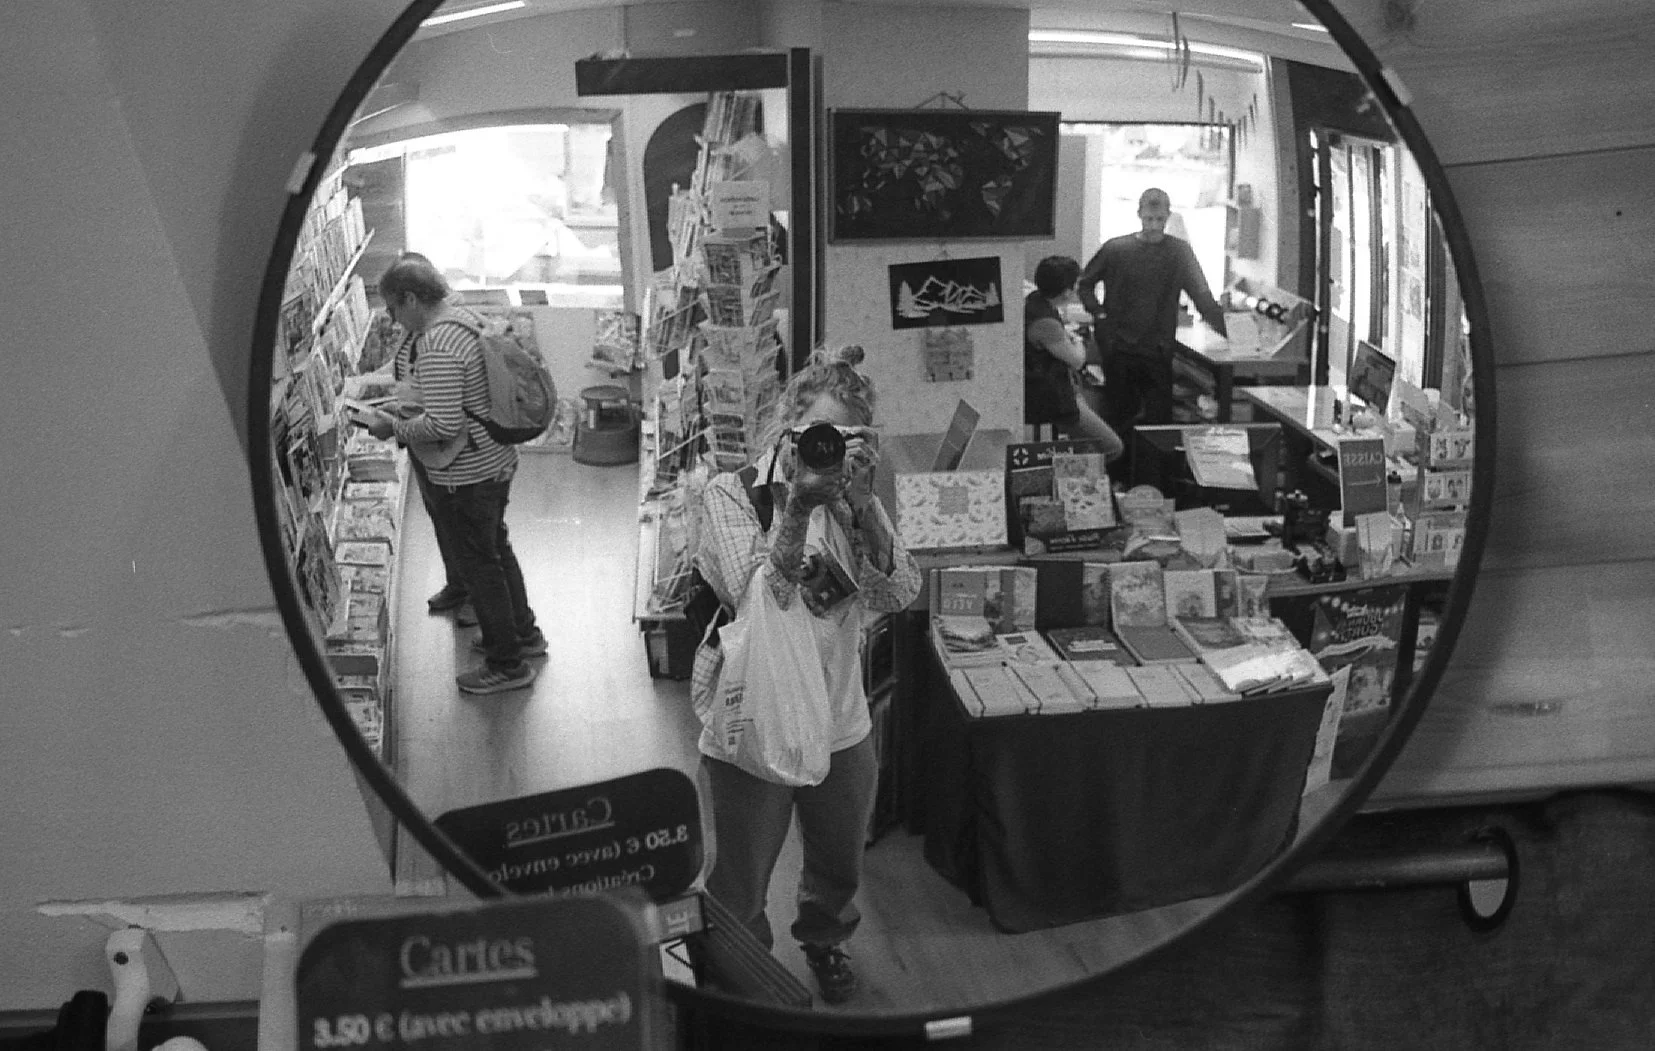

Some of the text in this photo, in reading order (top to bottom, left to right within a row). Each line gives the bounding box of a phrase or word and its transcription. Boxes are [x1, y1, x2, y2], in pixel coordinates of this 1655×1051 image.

[402, 934, 536, 977] Cartes
[375, 1012, 395, 1042] €
[400, 1008, 470, 1041] (avec
